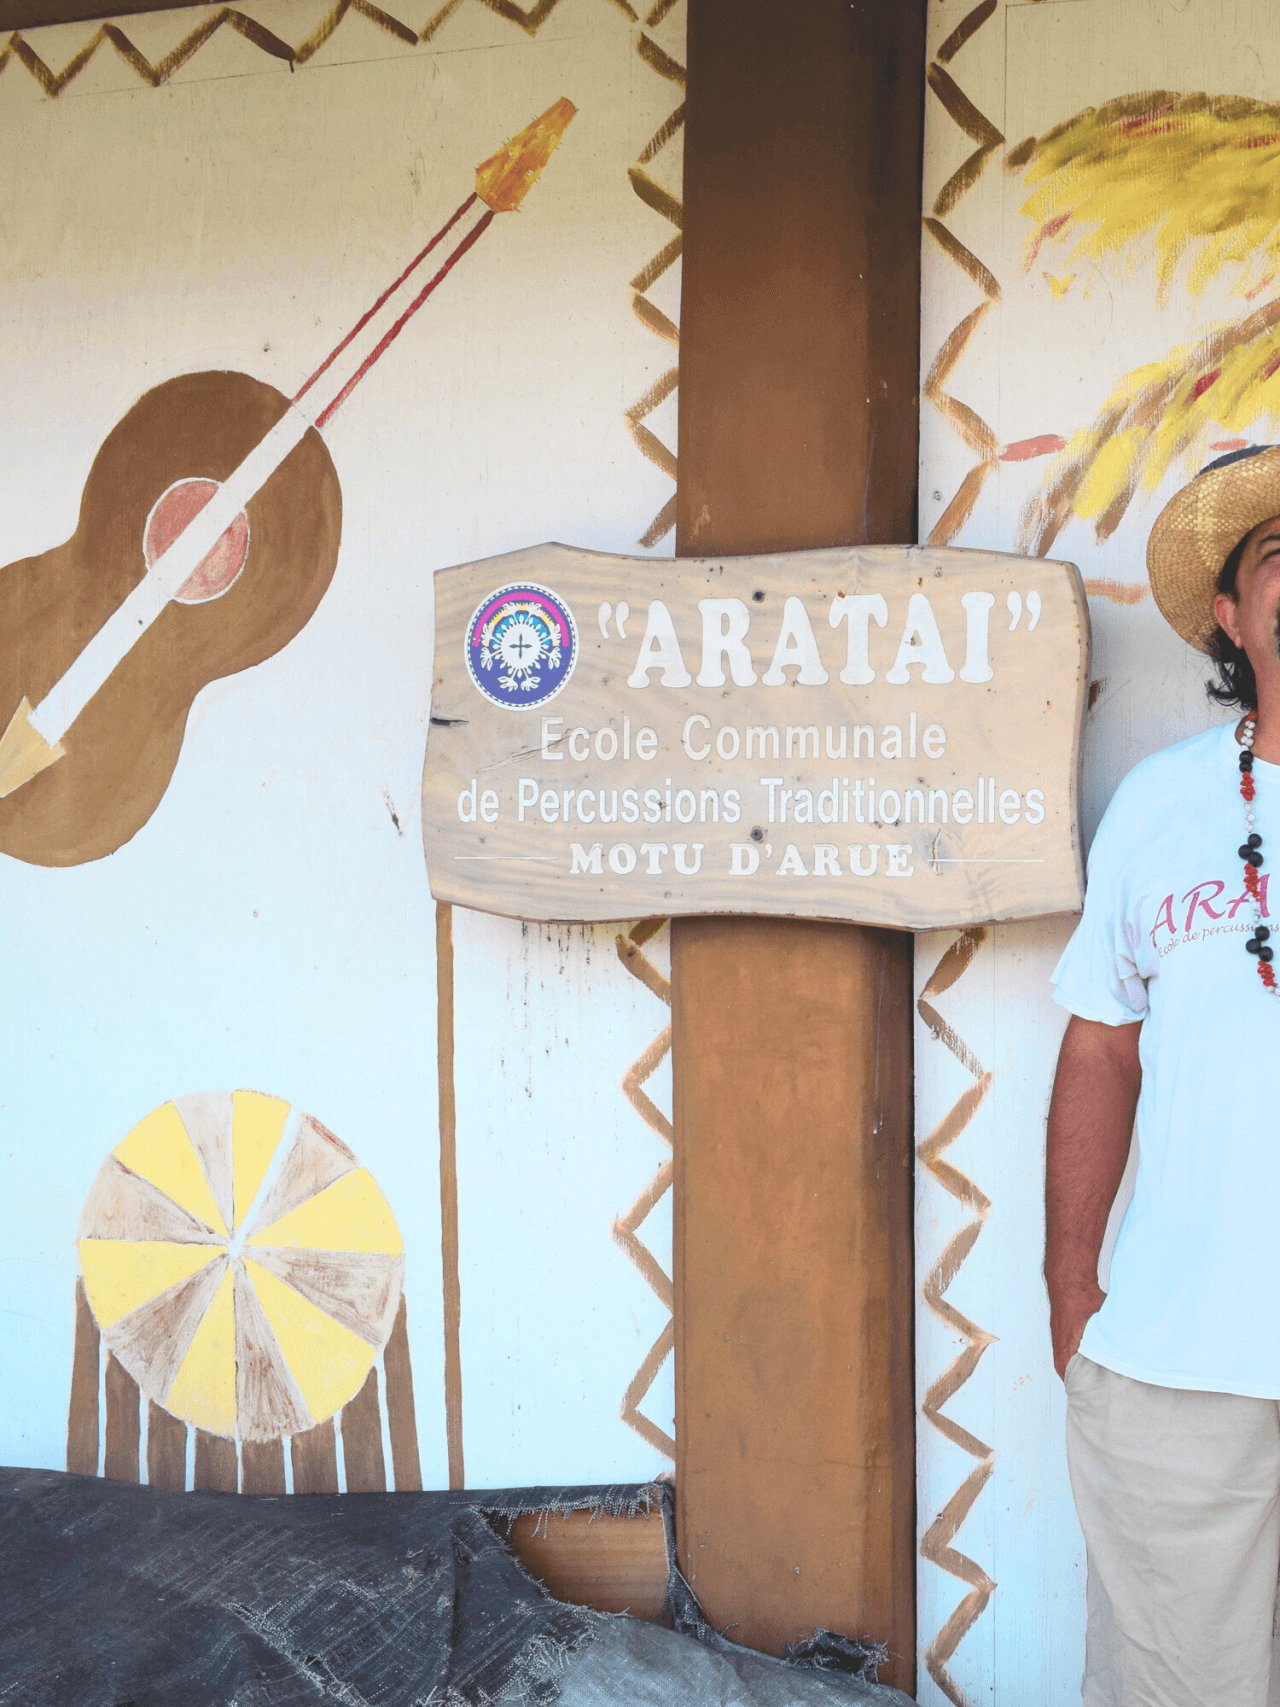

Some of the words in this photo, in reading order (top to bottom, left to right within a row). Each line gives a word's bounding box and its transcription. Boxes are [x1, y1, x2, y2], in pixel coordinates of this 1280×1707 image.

[540, 716, 658, 760] Ecole
[681, 712, 947, 759] Communale
[457, 779, 499, 823] de
[517, 777, 742, 823] Percussions
[760, 777, 1045, 824] Traditionnelles
[569, 843, 705, 876] MOTU
[1182, 931, 1200, 944] de
